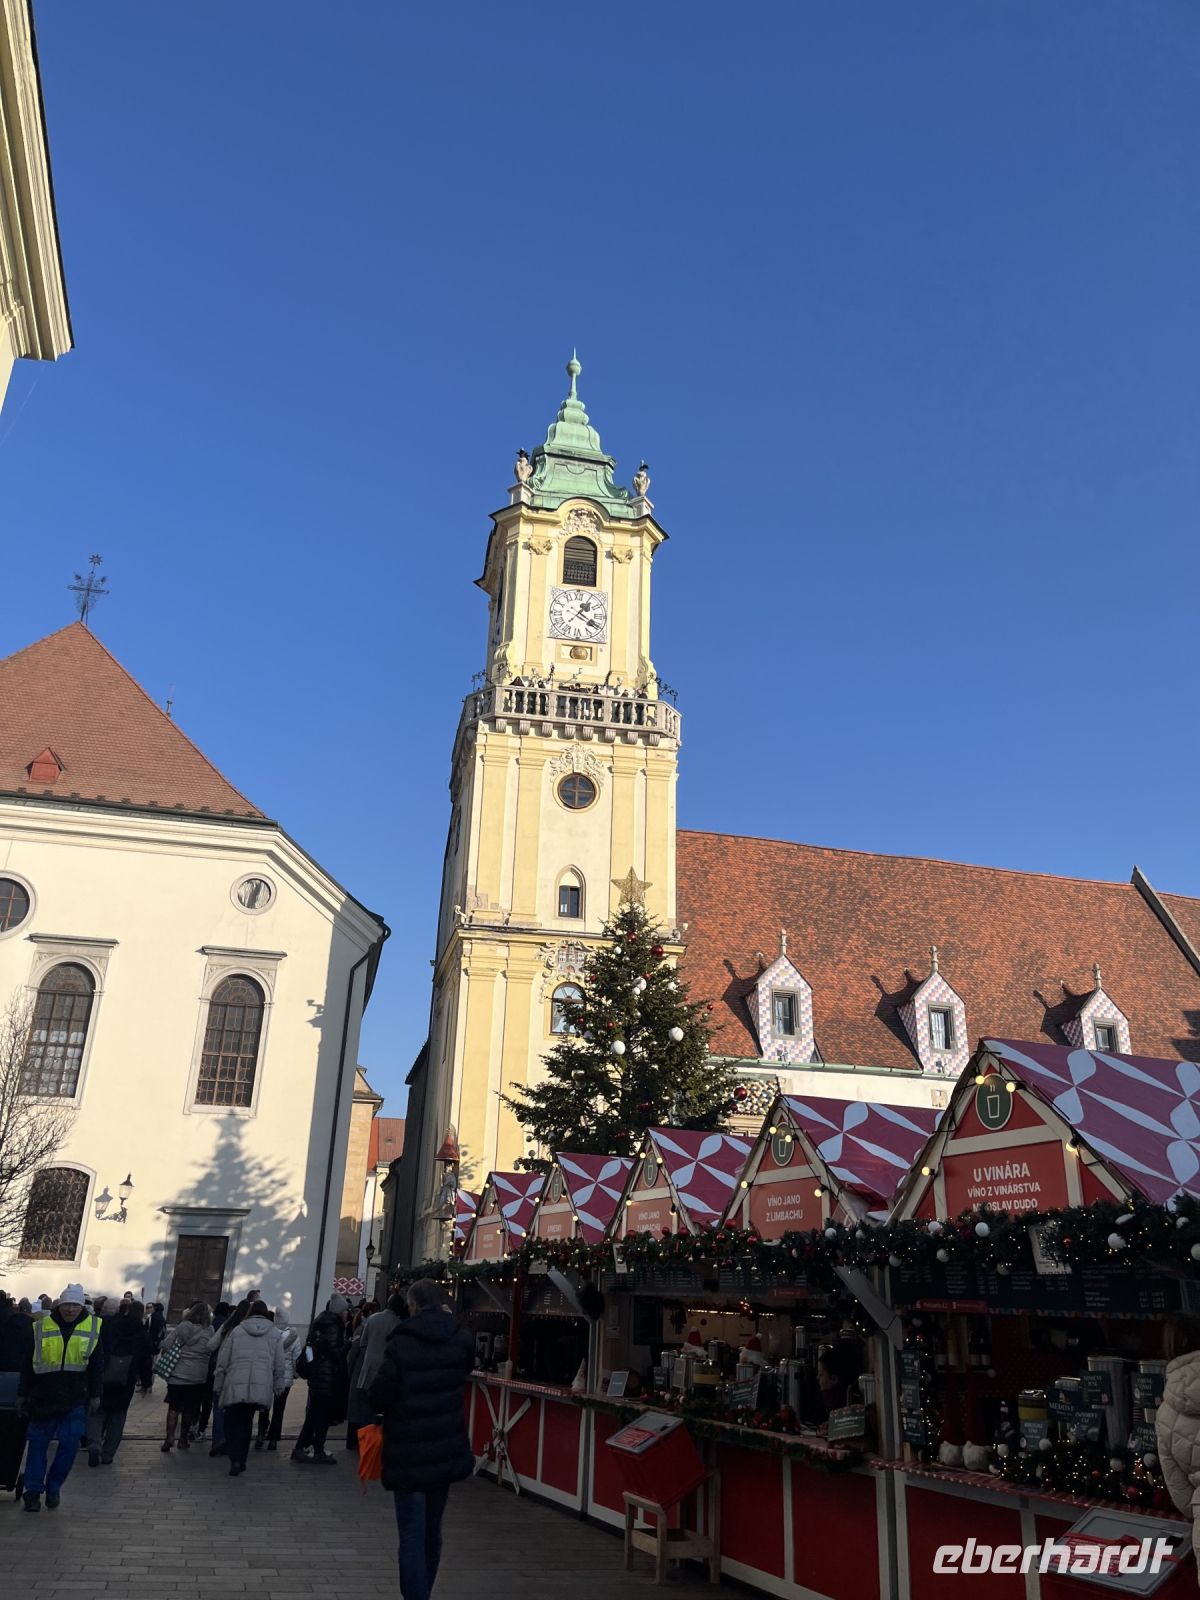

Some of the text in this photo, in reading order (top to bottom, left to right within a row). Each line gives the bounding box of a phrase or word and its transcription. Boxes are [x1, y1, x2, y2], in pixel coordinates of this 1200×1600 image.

[973, 1160, 1031, 1182] U VINÁRA
[967, 1181, 1041, 1198] VÍNO Z VINÁRSTVA
[783, 1194, 801, 1206] JANO
[972, 1198, 1038, 1213] MOSLAV DUDO
[766, 1209, 804, 1222] Z LIMBACHU
